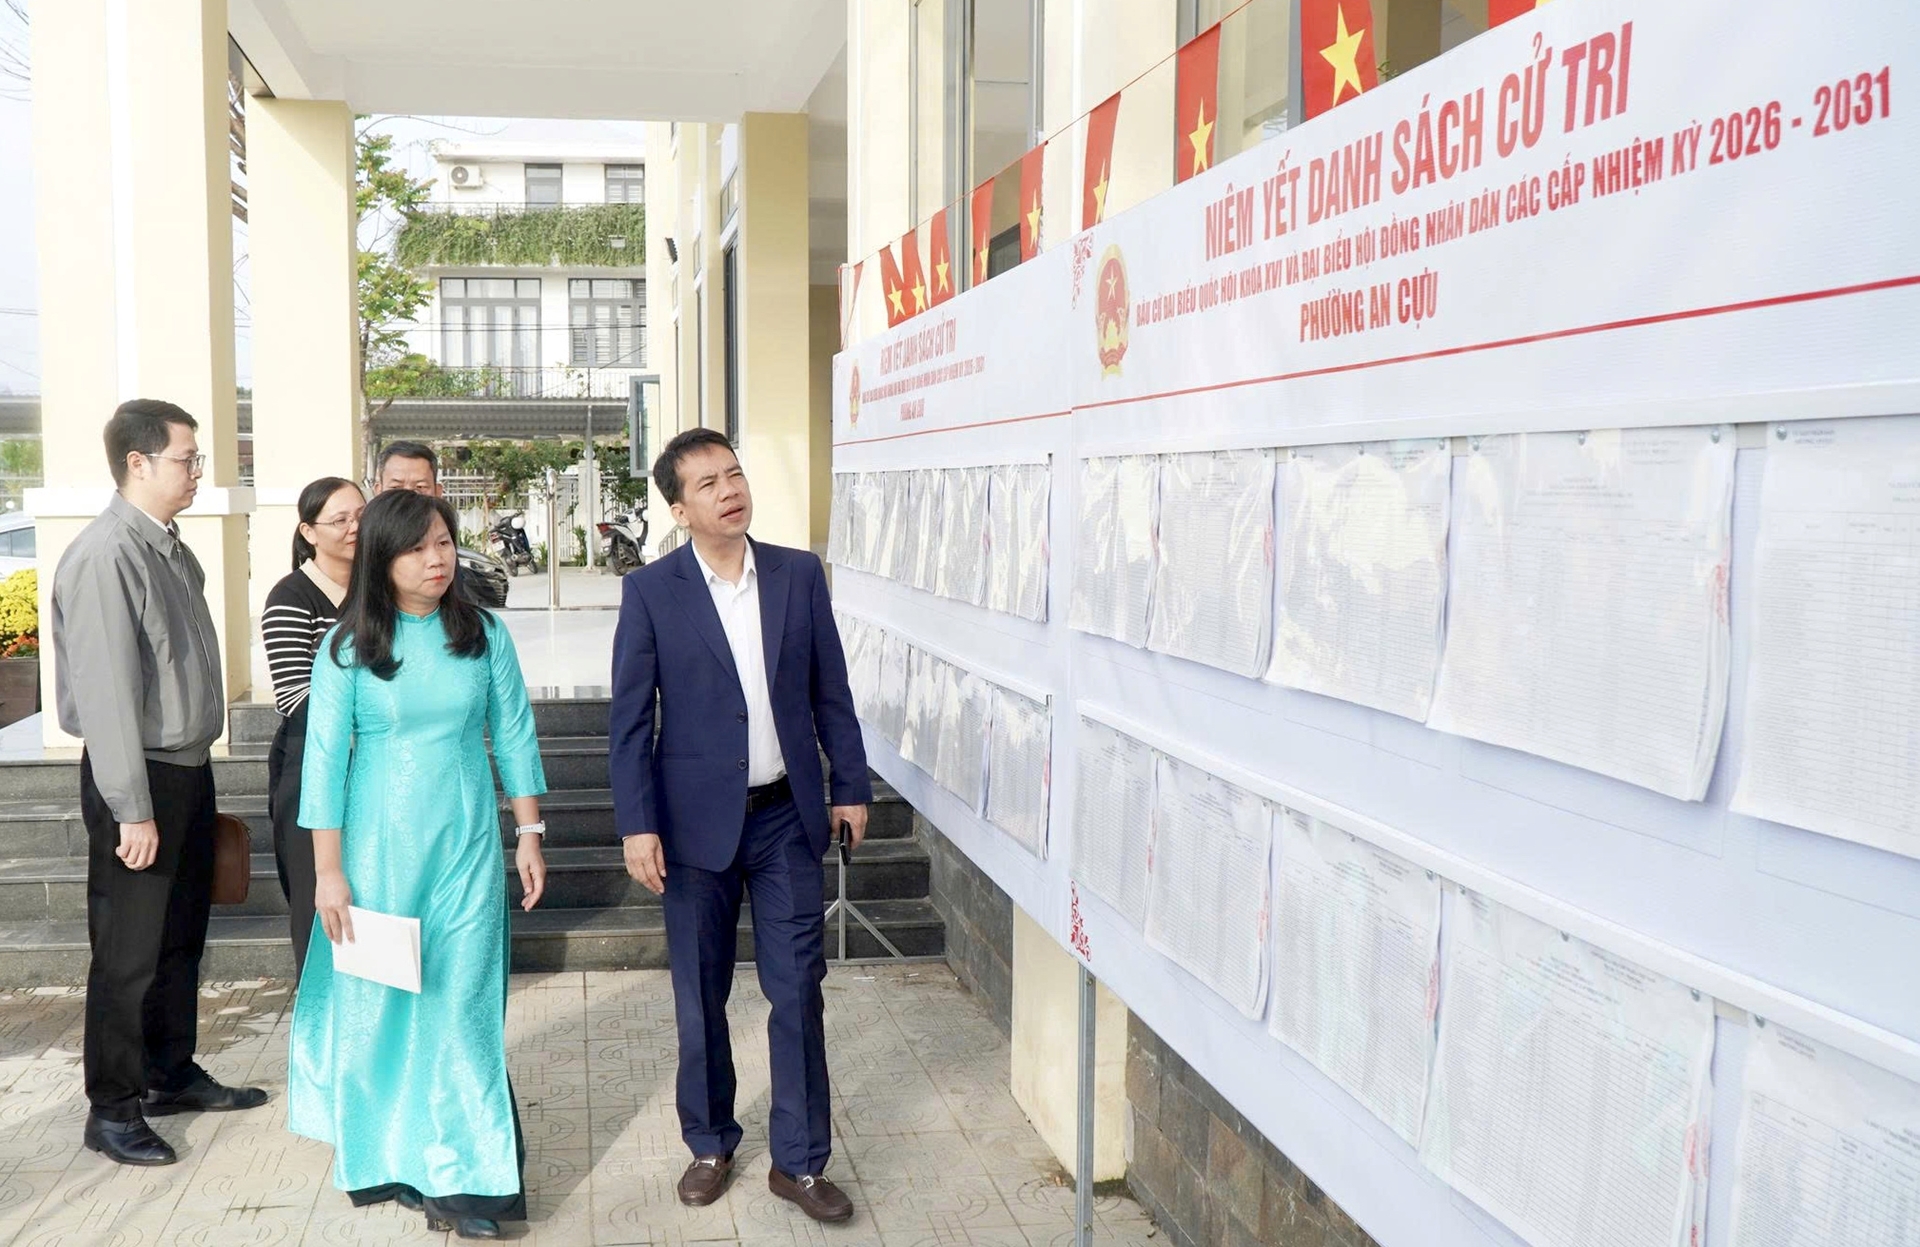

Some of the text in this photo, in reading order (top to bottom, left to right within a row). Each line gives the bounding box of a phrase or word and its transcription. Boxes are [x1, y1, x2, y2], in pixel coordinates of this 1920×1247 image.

[1199, 275, 1219, 313] QUỐC
[1264, 258, 1283, 291] XVI
[1286, 250, 1300, 285] VÀ
[1301, 247, 1320, 284] ĐẠI
[1323, 229, 1352, 275] BIỂU
[1355, 226, 1376, 270] HỘI
[1379, 212, 1420, 259] ĐỒNG
[1426, 200, 1465, 247] NHÂN
[1468, 188, 1500, 234] DÂN
[1505, 174, 1541, 223] CÁC
[1546, 151, 1585, 212] CẤP
[1592, 136, 1664, 198] NHIỆM
[1670, 118, 1702, 176] KỲ
[1709, 99, 1782, 165] 2026
[1791, 117, 1802, 127] -
[1812, 65, 1890, 137] 2031
[1205, 20, 1633, 261] NIÊM YẾT DANH SÁCH CỬ TRI
[1299, 287, 1365, 342] PHƯỜNG
[1369, 283, 1391, 329] AN
